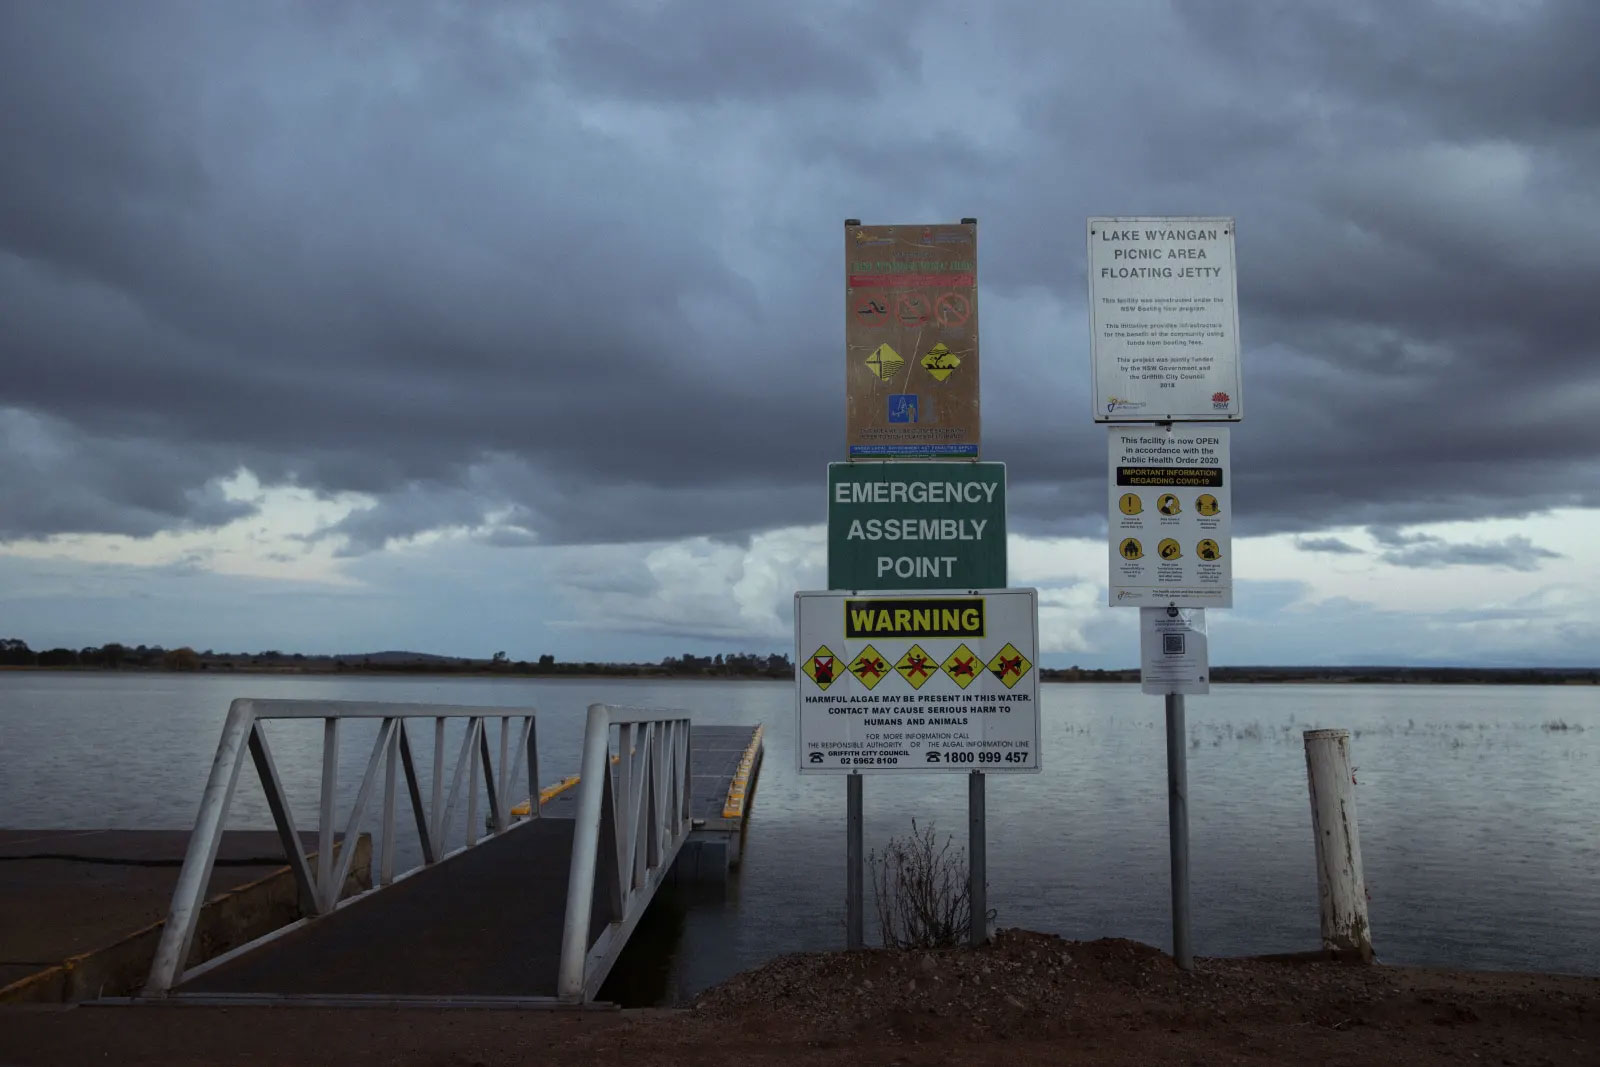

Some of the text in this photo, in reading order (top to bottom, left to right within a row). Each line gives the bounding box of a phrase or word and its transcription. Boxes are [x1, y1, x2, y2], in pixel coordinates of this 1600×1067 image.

[1102, 230, 1217, 241] LAKE WYANGAN
[1114, 249, 1207, 260] PICNIC AREA
[1101, 267, 1221, 278] FLOATING JETTY
[1140, 437, 1165, 445] facility
[835, 482, 998, 503] EMERGENCY
[847, 519, 988, 540] ASSEMBLY
[877, 557, 958, 578] POINT
[851, 609, 980, 631] WARNING
[828, 707, 869, 715] CONTACT
[864, 718, 903, 726] HUMANS
[906, 718, 925, 726] AND
[943, 752, 1029, 763] 1800 999 457
